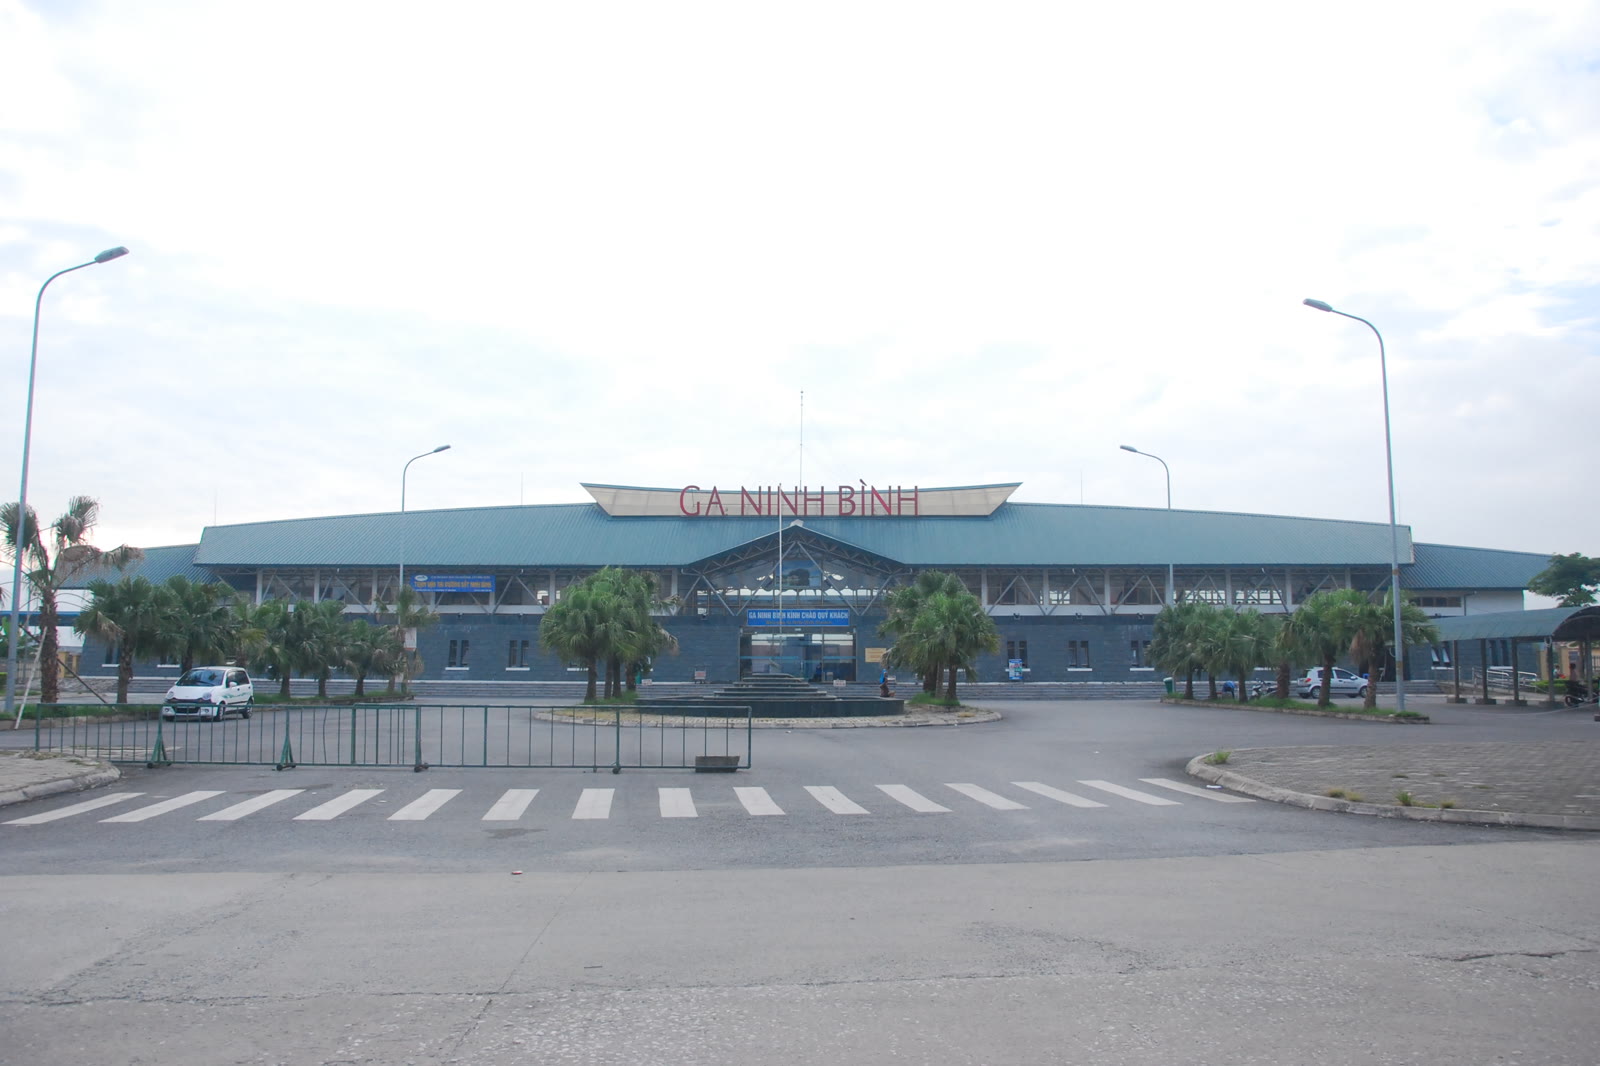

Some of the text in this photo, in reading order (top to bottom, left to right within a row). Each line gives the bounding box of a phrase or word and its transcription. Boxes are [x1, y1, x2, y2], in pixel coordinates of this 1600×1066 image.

[680, 479, 919, 516] GA NINH BÌNH
[749, 611, 756, 619] GA
[758, 611, 771, 619] NINH
